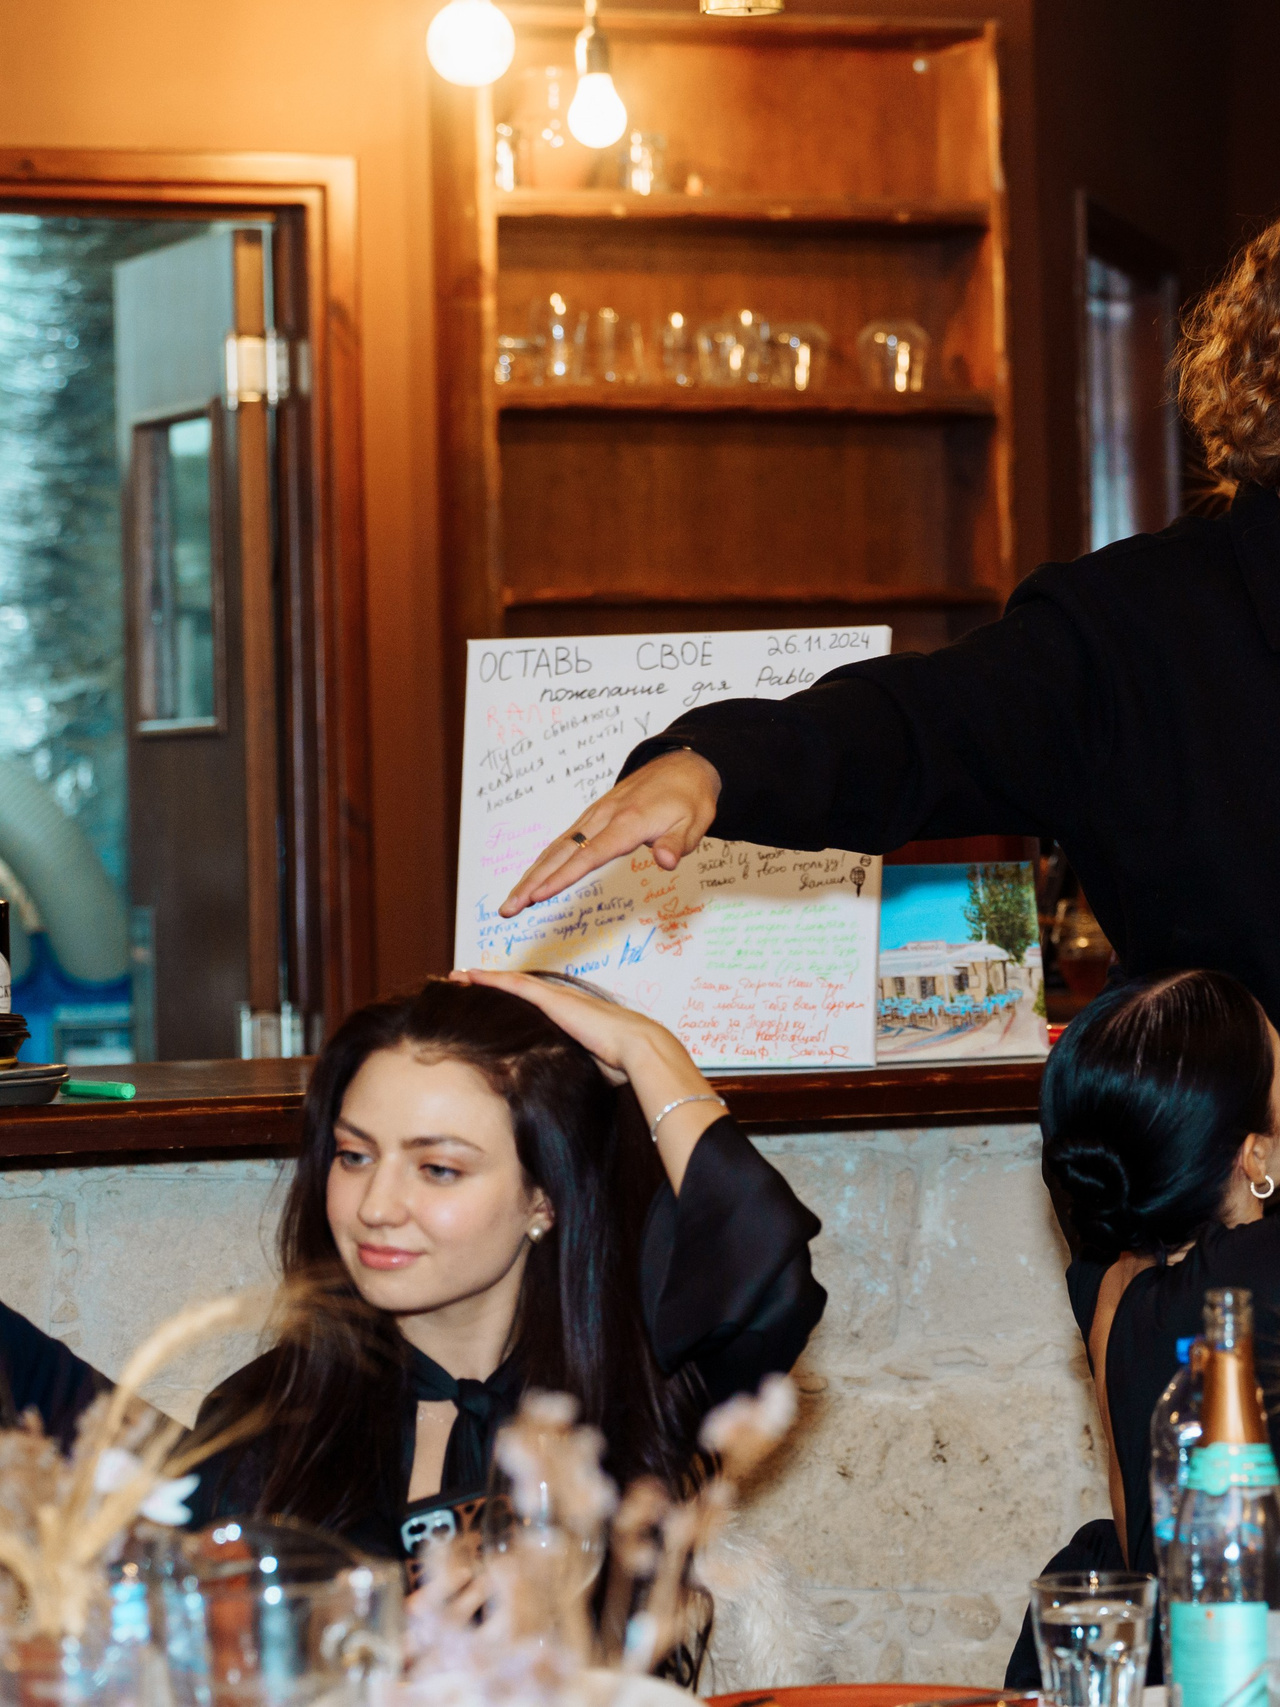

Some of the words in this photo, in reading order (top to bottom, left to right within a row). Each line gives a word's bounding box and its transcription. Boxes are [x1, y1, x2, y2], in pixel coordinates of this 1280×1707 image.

[479, 645, 593, 683] ОСТАВЬ
[636, 635, 714, 671] СВОЁ
[767, 631, 871, 656] 26.11.2024
[539, 682, 670, 703] пожелание
[682, 680, 732, 707] для
[755, 665, 815, 688] Pablo
